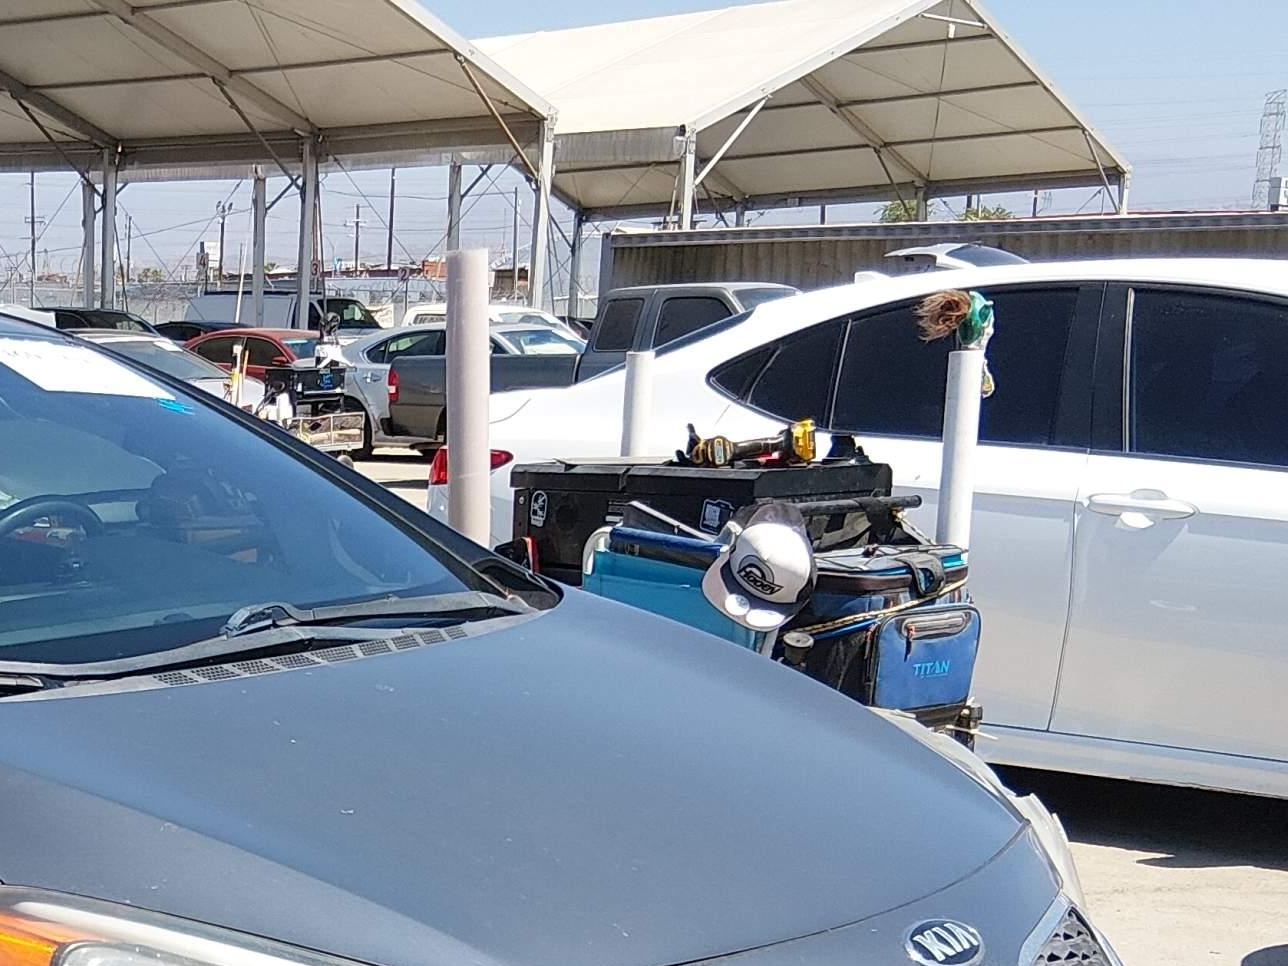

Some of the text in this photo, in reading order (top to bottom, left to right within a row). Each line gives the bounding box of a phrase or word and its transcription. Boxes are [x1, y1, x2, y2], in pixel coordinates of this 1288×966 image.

[199, 254, 206, 269] 4
[311, 262, 319, 276] 3
[401, 268, 408, 281] 2
[913, 660, 951, 676] TITAN
[912, 923, 979, 961] KIA
